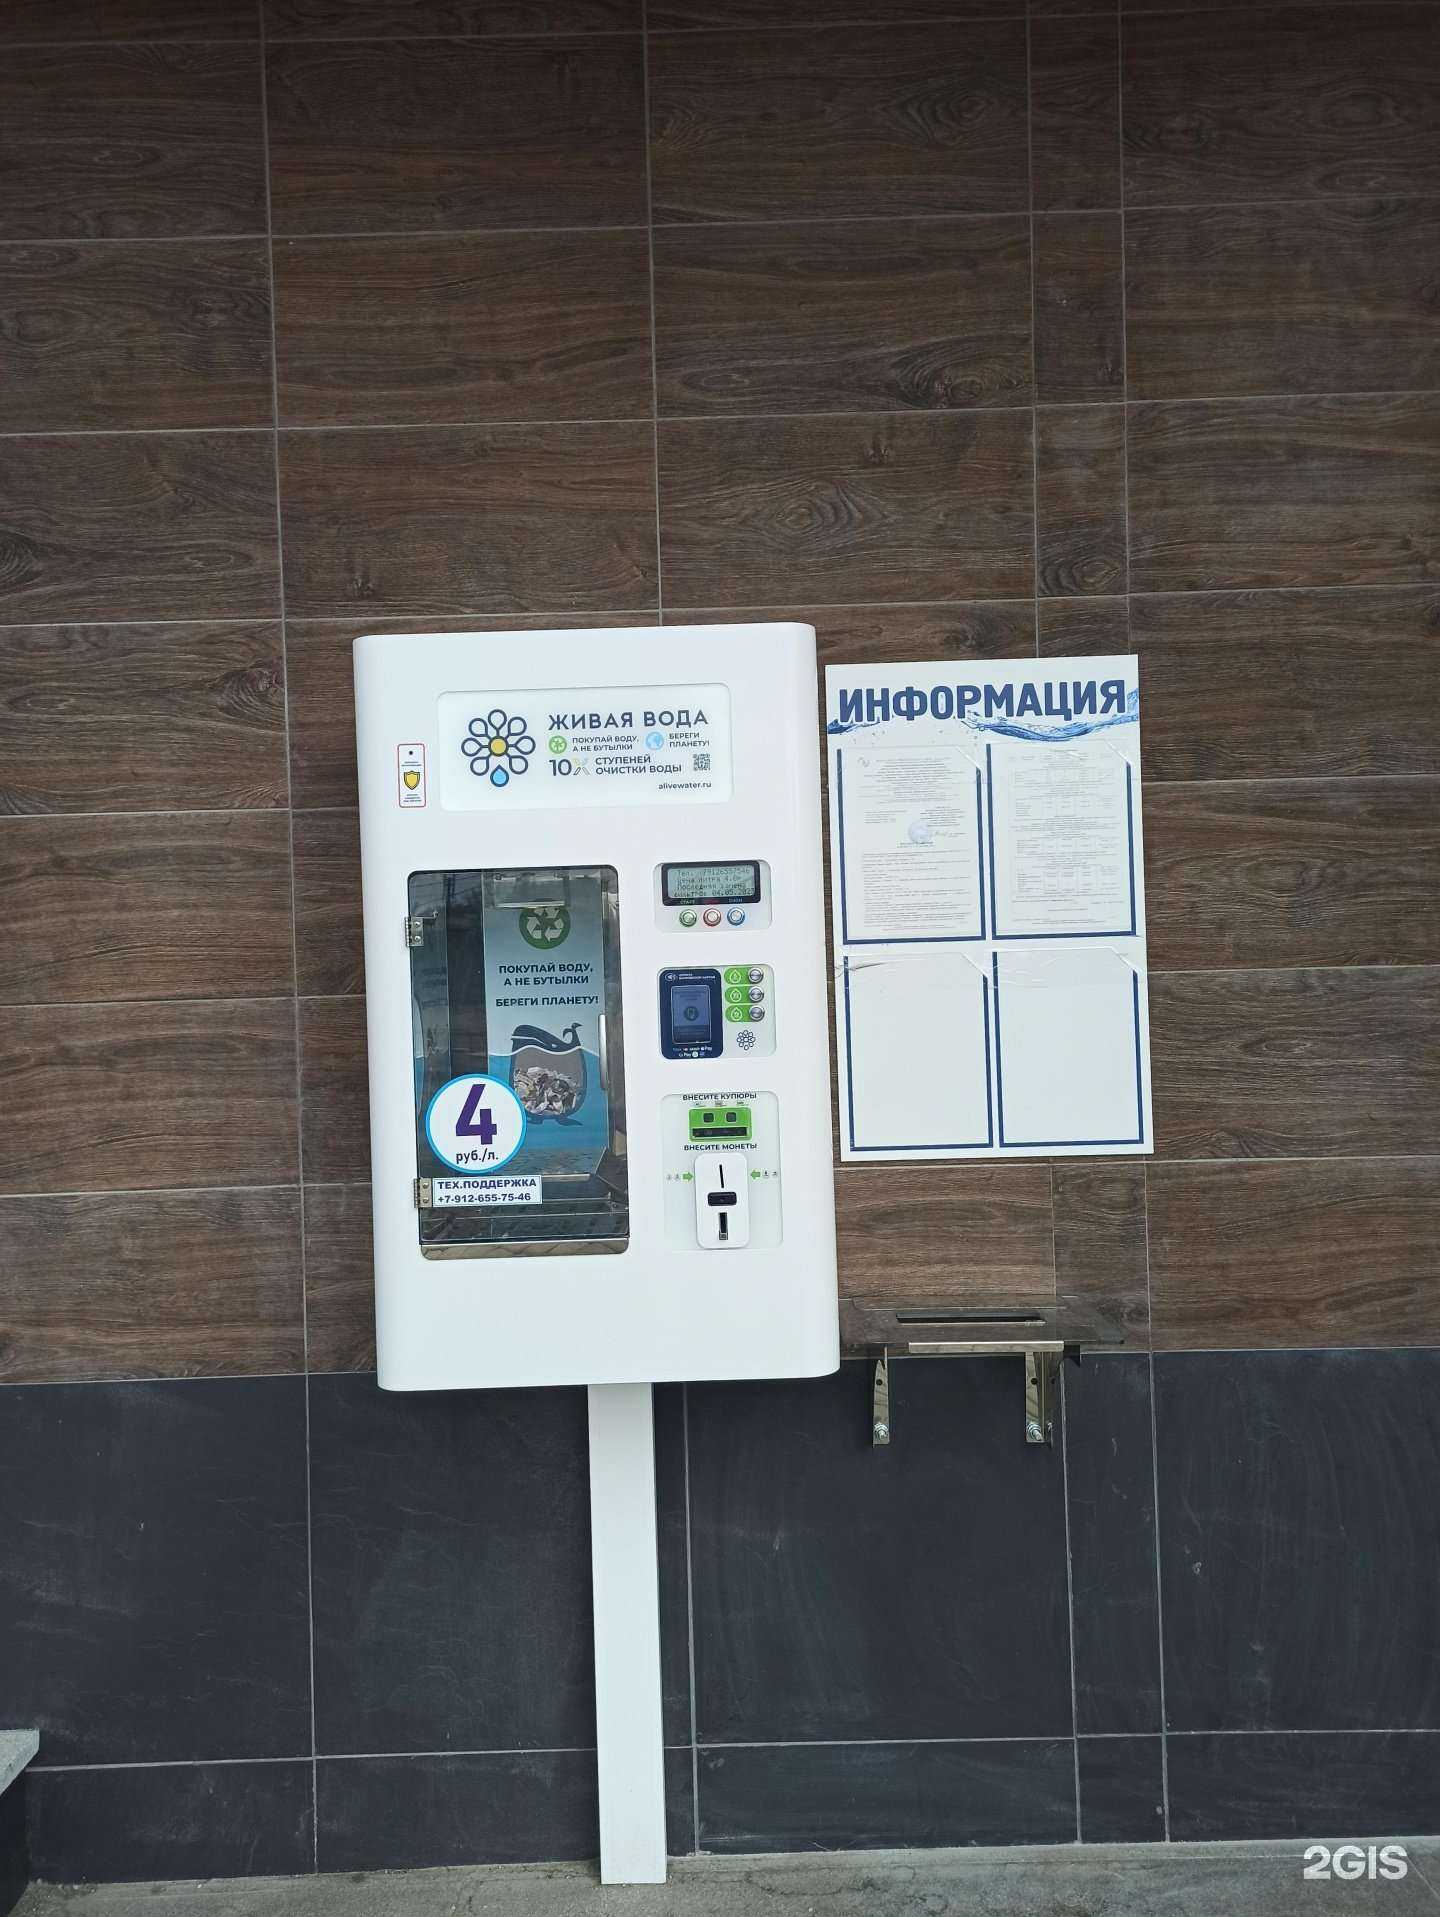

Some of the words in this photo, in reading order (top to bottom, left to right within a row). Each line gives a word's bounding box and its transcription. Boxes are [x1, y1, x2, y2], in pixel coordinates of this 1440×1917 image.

[839, 679, 1126, 722] ИНФОРМАЦИЯ
[548, 712, 633, 731] ЖИВАЯ
[643, 709, 709, 728] ВОДА
[572, 735, 613, 744] ПОКУПАЙ
[669, 732, 700, 740] БЕРЕГИ
[593, 744, 633, 752] БУТЫЛКИ
[669, 740, 710, 748] ПЛАНЕТУ!
[595, 754, 651, 766] СТУПЕНЕЙ
[595, 765, 647, 775] ОЧИСТКИ
[649, 764, 682, 774] ВОДЫ
[658, 781, 712, 790] alivewater.ru
[498, 962, 556, 975] ПОКУПАЙ
[558, 962, 594, 974] ВОДУ,
[503, 977, 513, 987] А
[514, 977, 530, 986] НЕ
[534, 975, 589, 986] БУТЫЛКИ
[495, 997, 539, 1008] БЕРЕГИ
[541, 996, 599, 1007] ПЛАНЕТУ!
[682, 1093, 719, 1101] ВНЕСИТЕ
[720, 1092, 757, 1100] КУПЮРЫ
[455, 1083, 498, 1145] 4
[721, 1143, 758, 1151] МОНЕТЫ
[455, 1148, 499, 1164] руб./л.
[437, 1179, 537, 1190] ТЕХ.ПОДДЕРЖКА
[437, 1192, 532, 1204] +7-912-655-75-46
